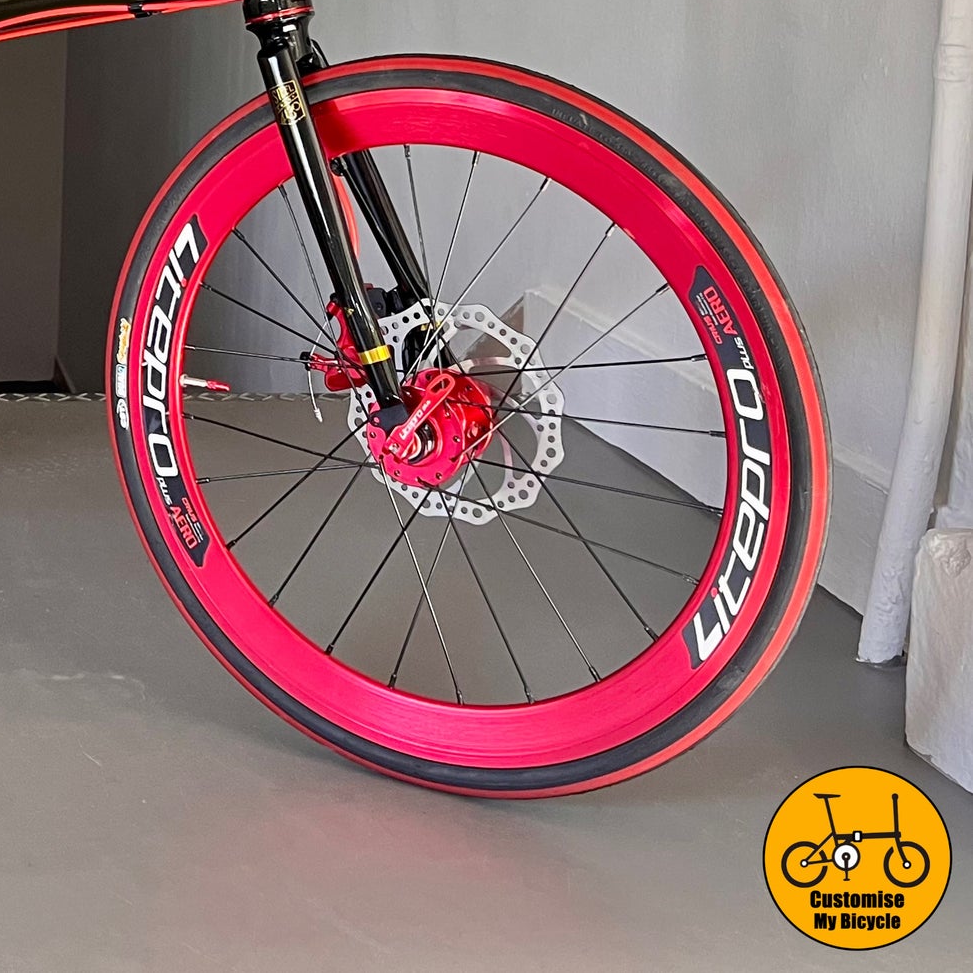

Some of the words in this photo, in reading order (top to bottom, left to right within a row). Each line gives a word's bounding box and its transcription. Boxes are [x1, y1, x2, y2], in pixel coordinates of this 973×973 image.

[142, 222, 200, 477] Litepro
[703, 286, 738, 335] AERO
[170, 506, 198, 549] AERO
[692, 368, 771, 662] Litepro
